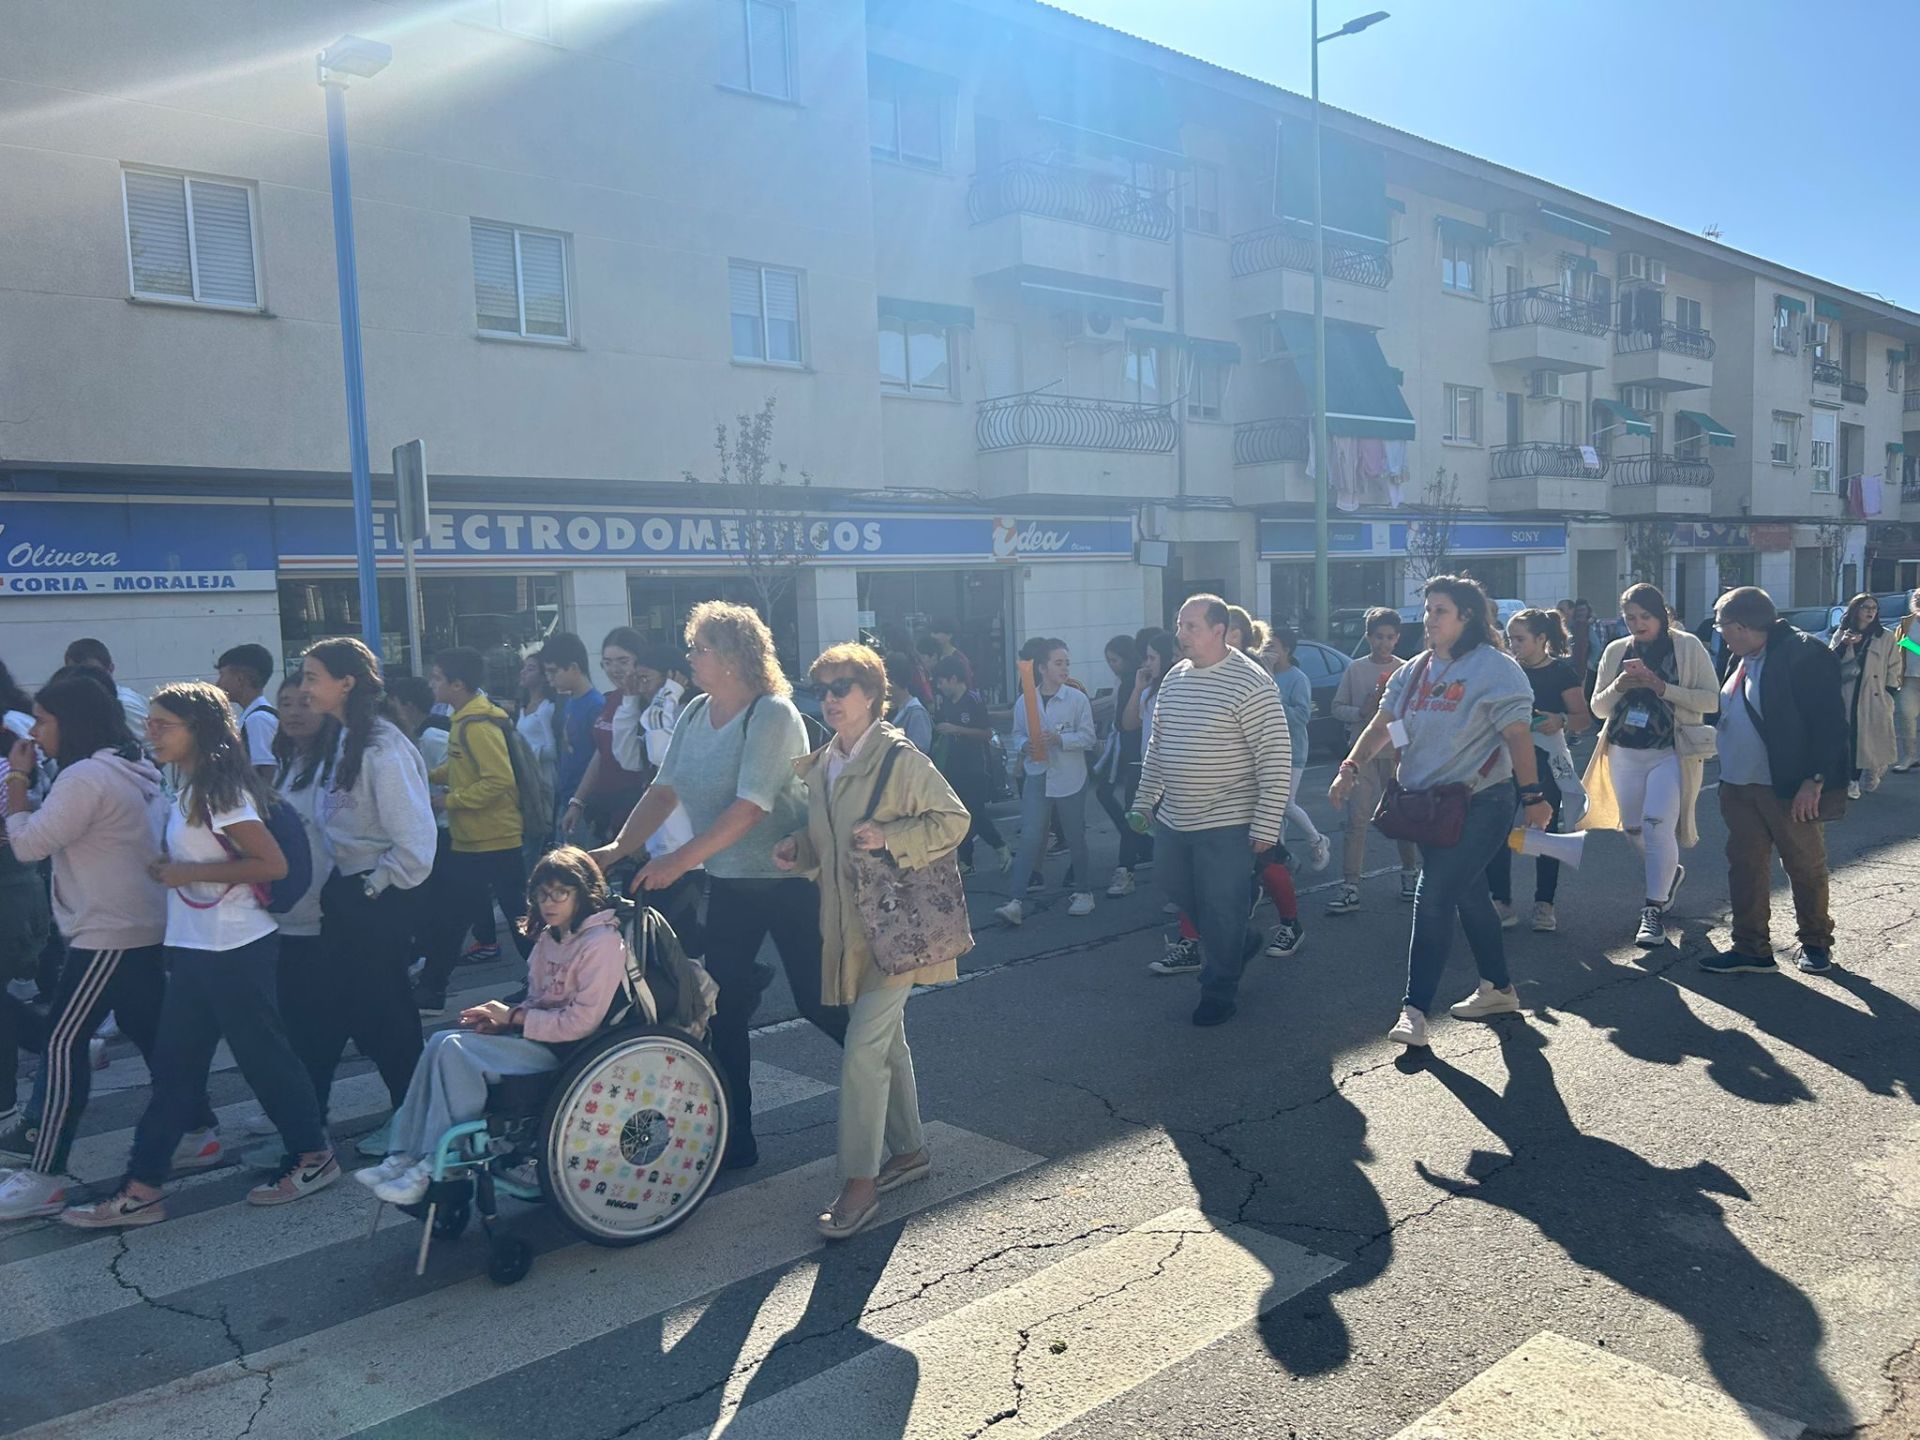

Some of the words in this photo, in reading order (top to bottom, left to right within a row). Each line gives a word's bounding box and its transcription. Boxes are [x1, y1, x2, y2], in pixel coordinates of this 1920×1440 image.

[1511, 530, 1541, 543] SONY
[7, 542, 121, 567] Olivera
[10, 577, 88, 592] CORIA
[113, 575, 236, 590] MORALEJA
